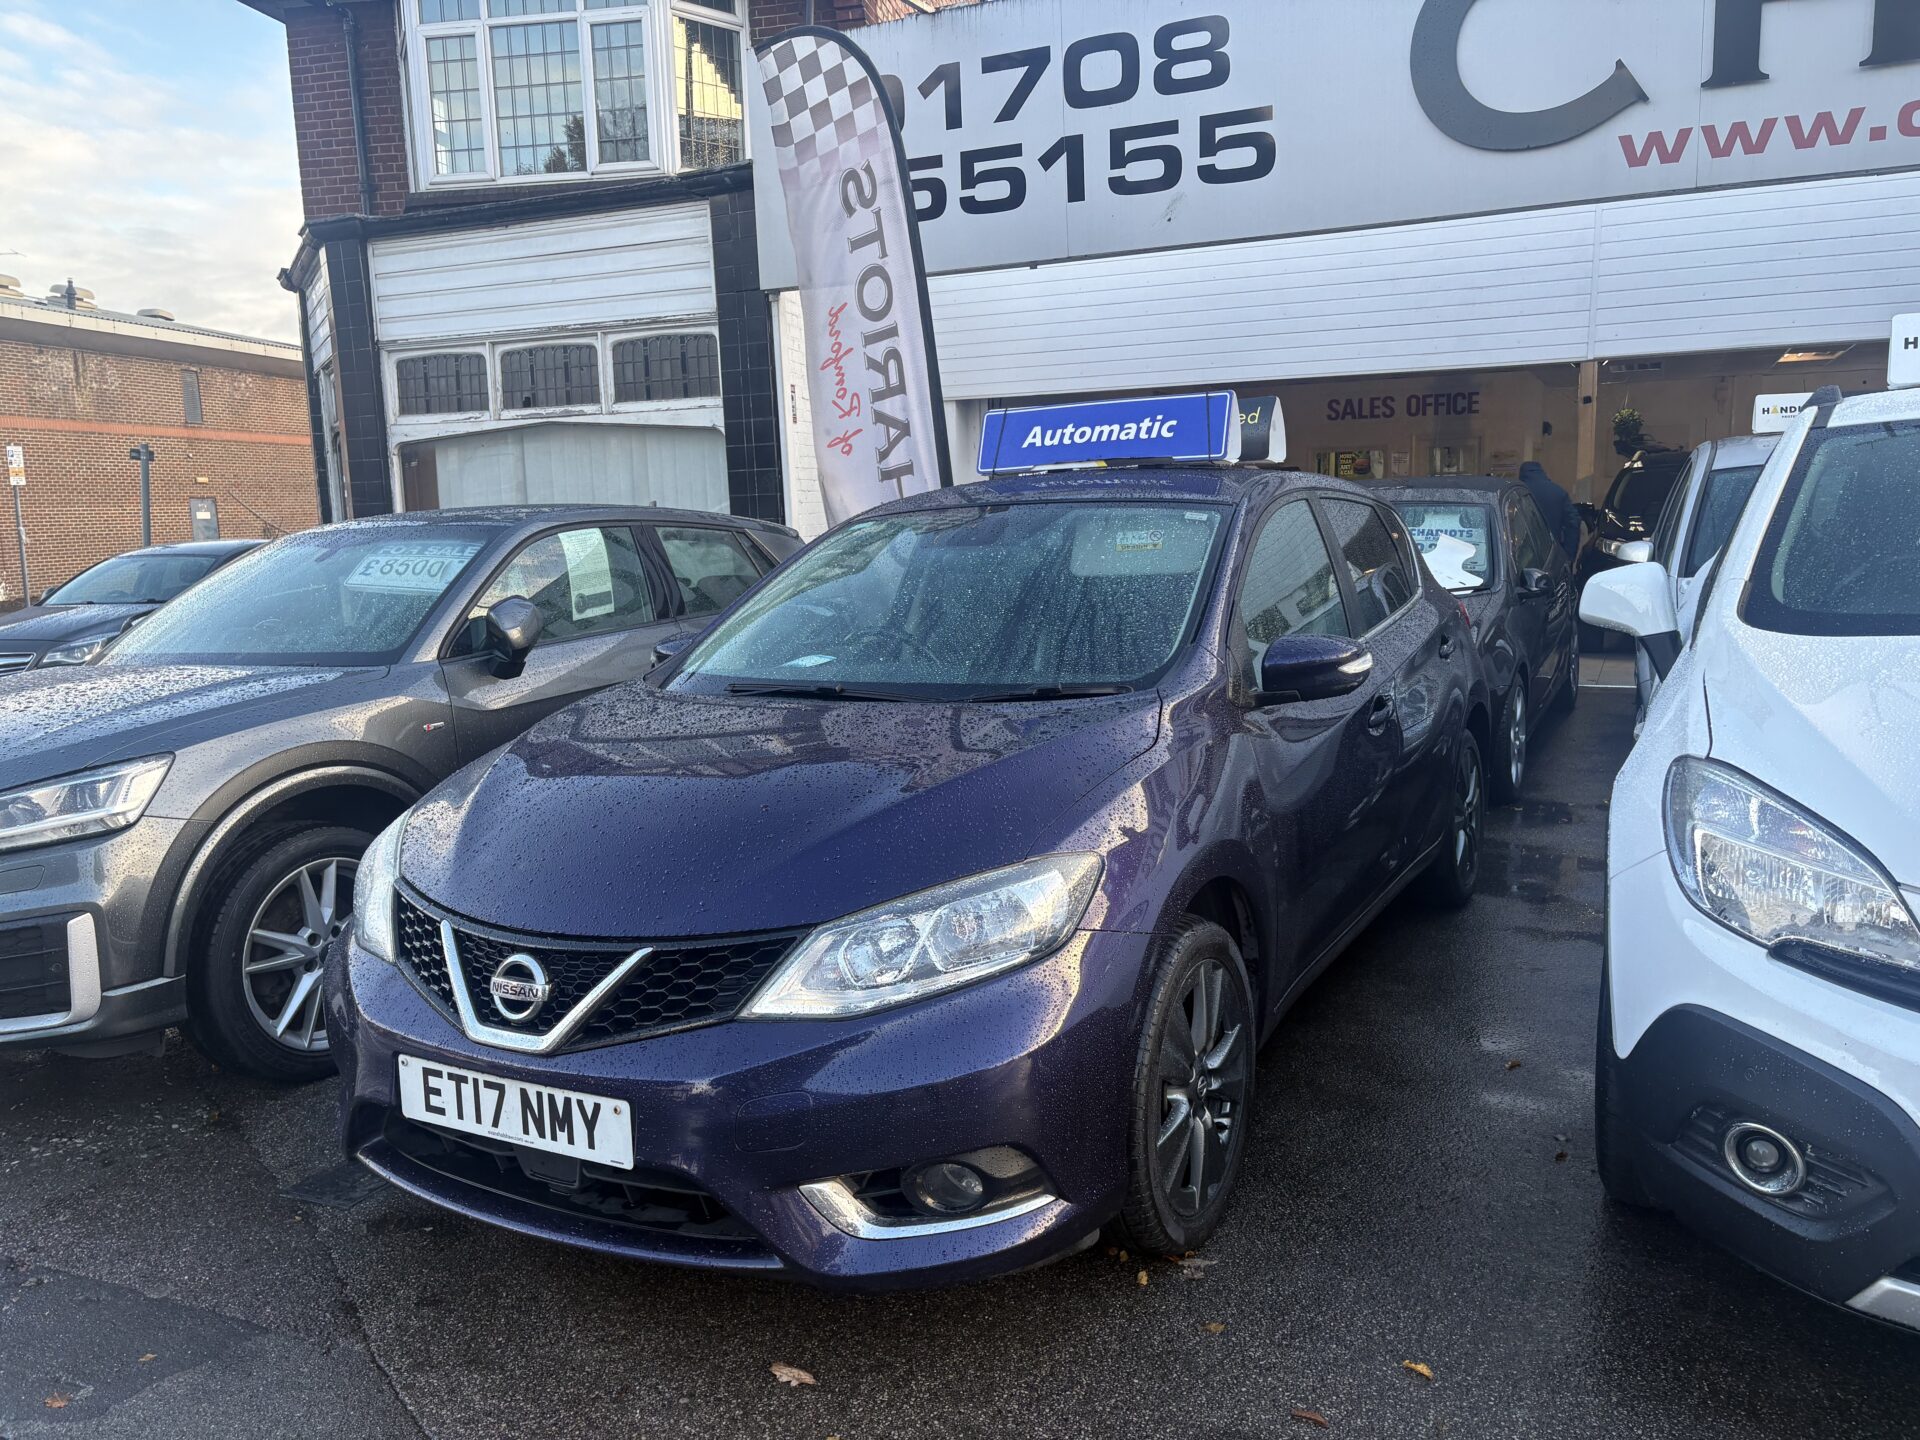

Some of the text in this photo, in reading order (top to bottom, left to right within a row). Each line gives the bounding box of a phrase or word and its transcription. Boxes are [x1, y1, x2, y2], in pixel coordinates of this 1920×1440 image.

[880, 15, 1231, 134] 1708
[907, 105, 1278, 222] 55155
[1238, 406, 1261, 425] ed
[1326, 391, 1480, 421] SALES OFFICE
[1021, 414, 1178, 449] Automatic
[380, 545, 481, 556] FOR SALE
[492, 981, 539, 998] NISSAN
[422, 1066, 602, 1150] ET17 NMY
